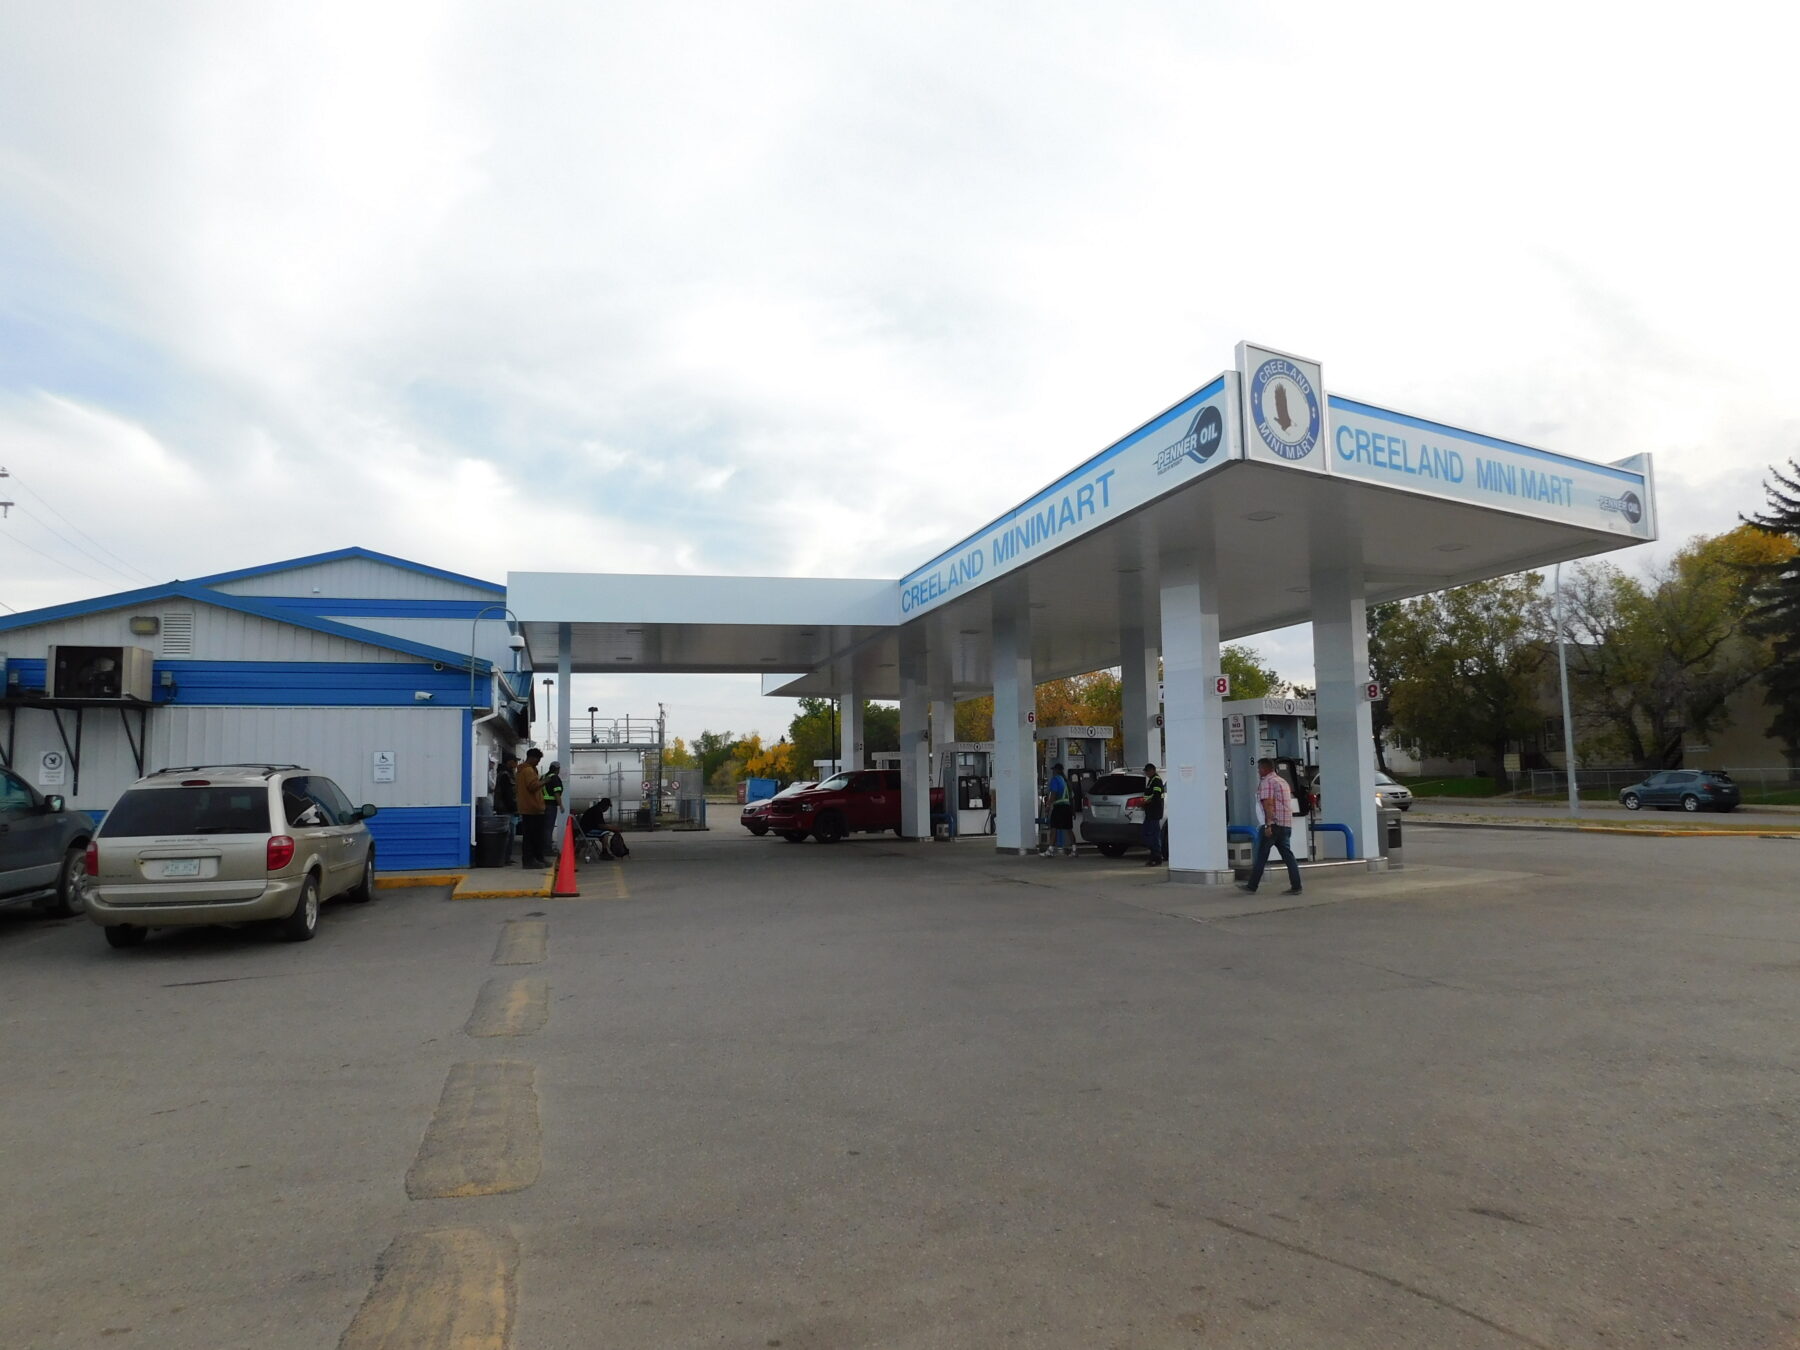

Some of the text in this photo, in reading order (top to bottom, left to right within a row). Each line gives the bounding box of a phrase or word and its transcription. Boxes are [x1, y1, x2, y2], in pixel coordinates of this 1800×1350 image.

[1259, 360, 1310, 394] CREELAND
[1157, 433, 1198, 470] PENNER
[1200, 422, 1218, 445] OIL
[1259, 422, 1315, 459] MINI MART
[1336, 424, 1573, 508] CREELAND MINI MART
[1627, 501, 1640, 514] OIL
[902, 549, 984, 613] CREELAND
[1216, 678, 1227, 693] 8
[1367, 684, 1378, 699] 8
[1028, 711, 1034, 723] 6
[1156, 715, 1163, 726] 6
